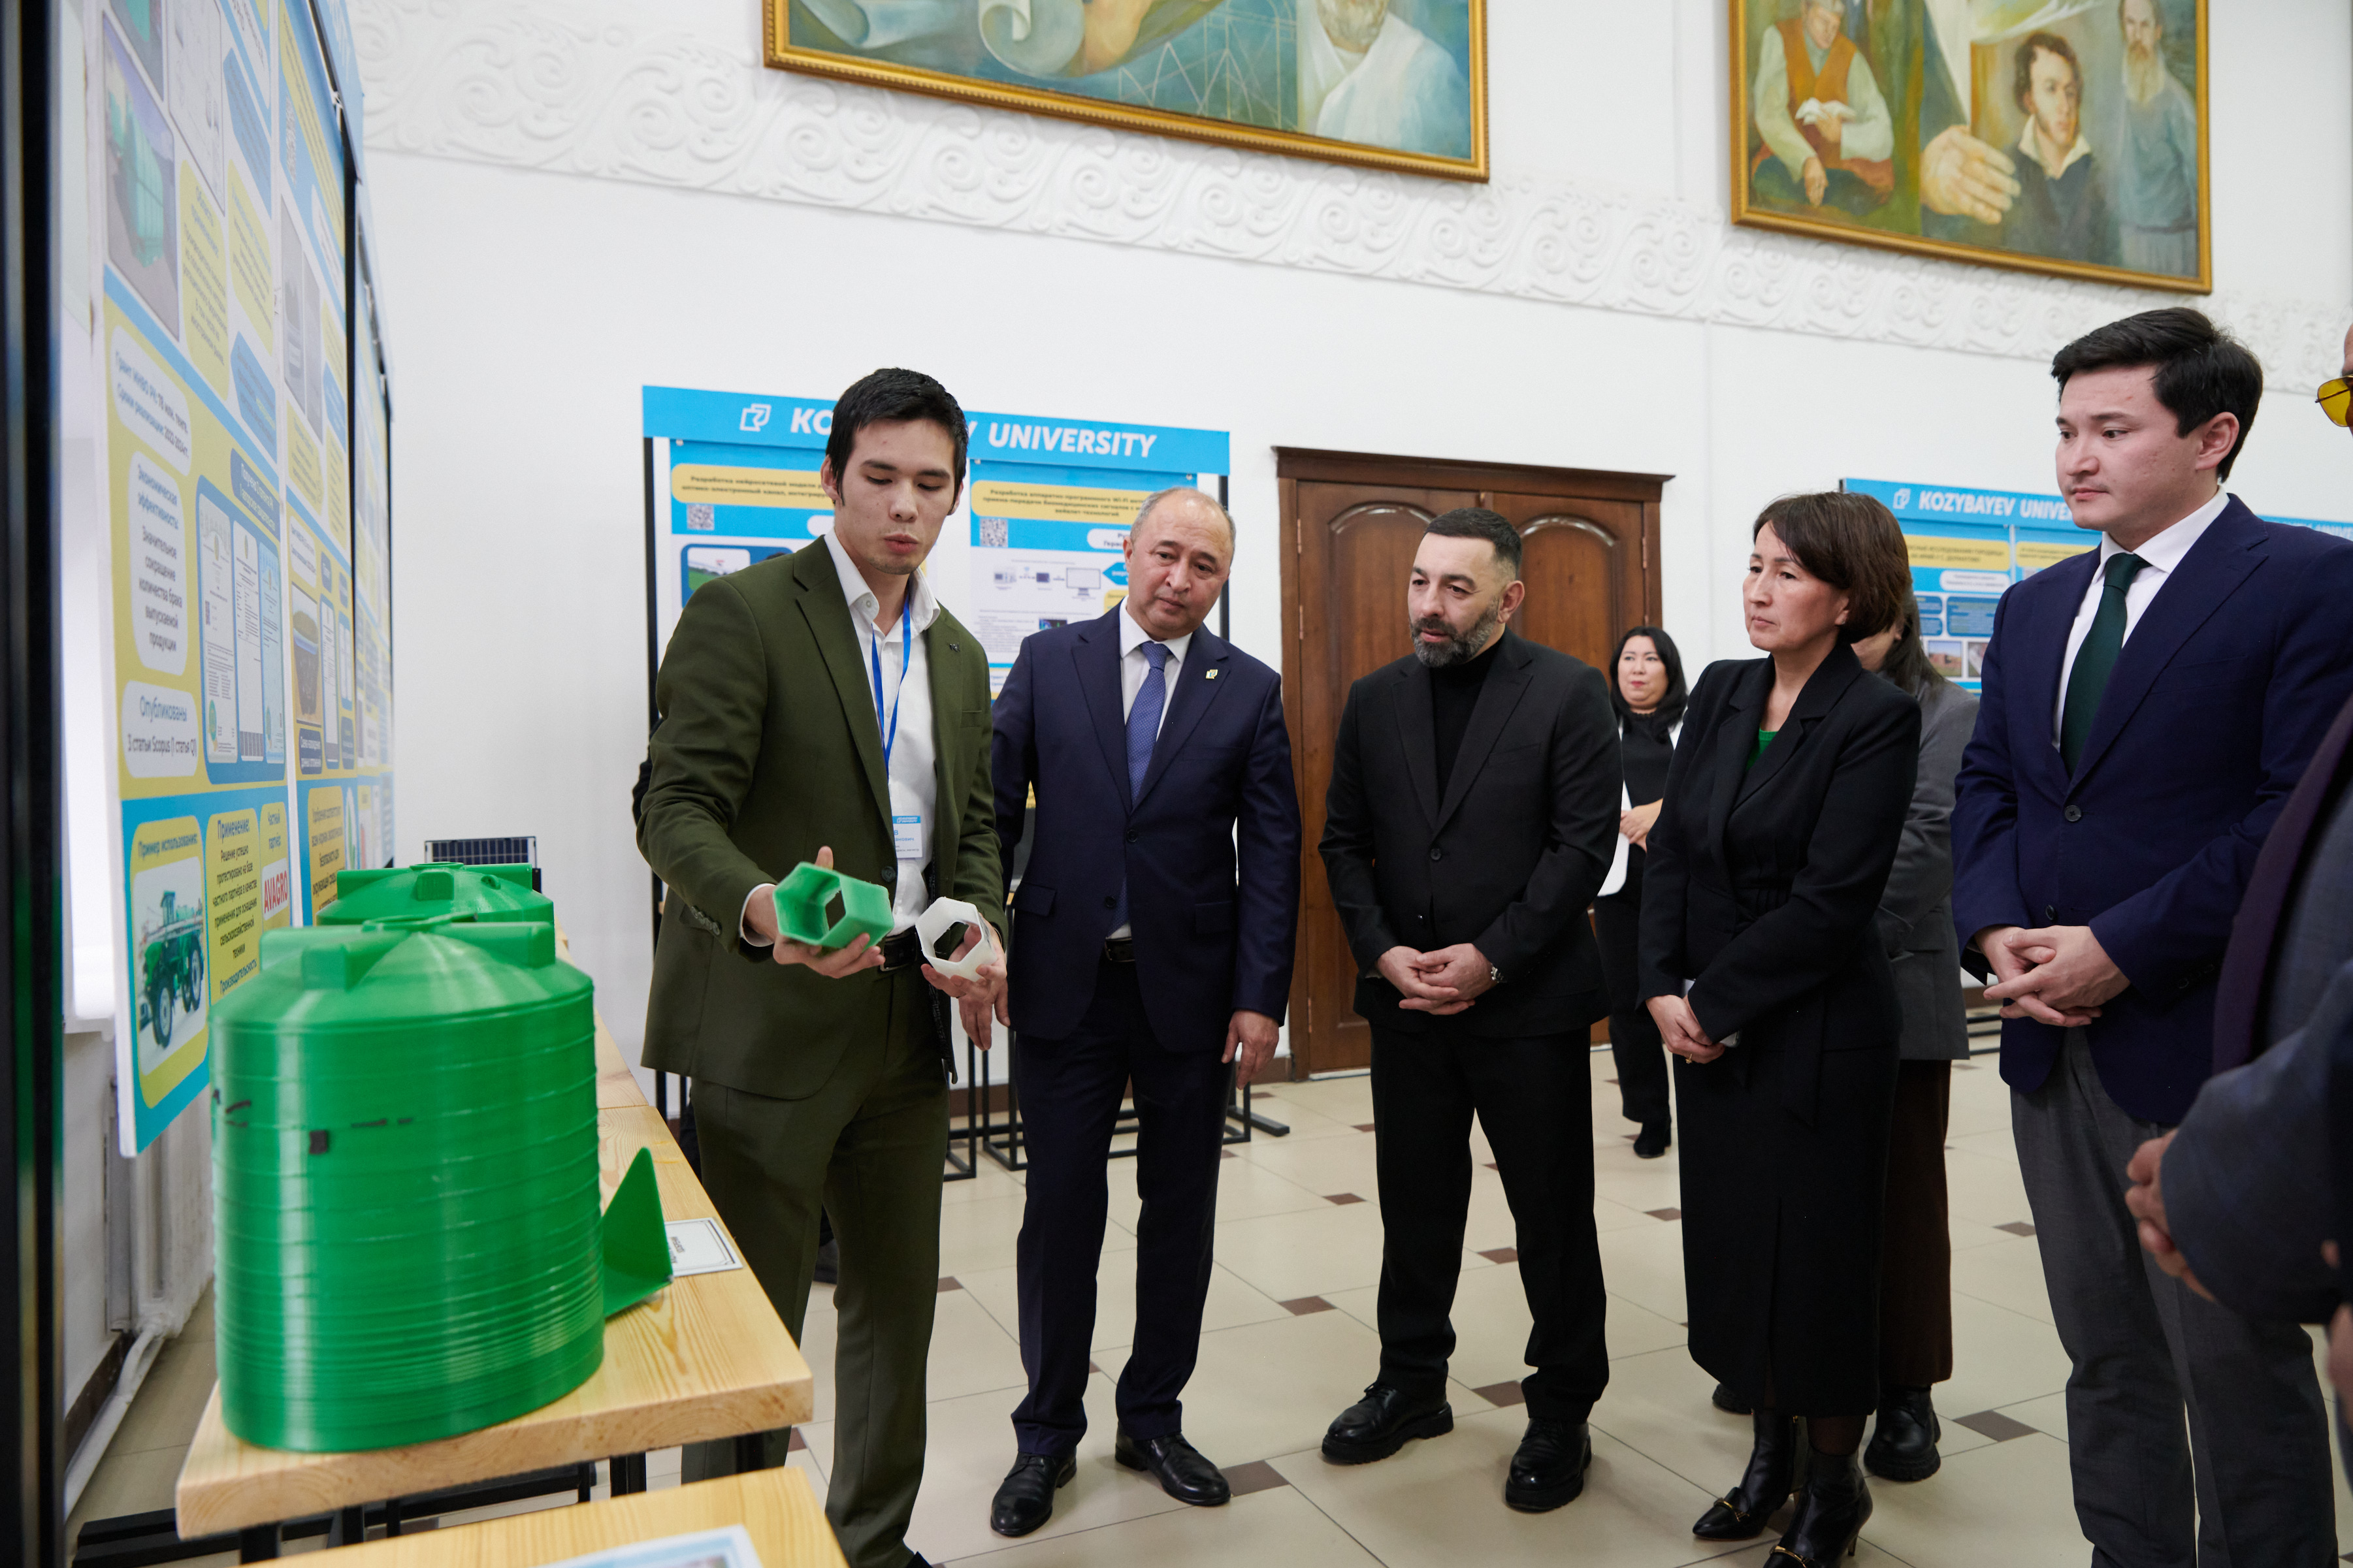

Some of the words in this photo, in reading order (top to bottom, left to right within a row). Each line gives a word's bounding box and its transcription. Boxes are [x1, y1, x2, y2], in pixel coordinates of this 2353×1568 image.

[988, 423, 1157, 457] UNIVERSITY
[1919, 491, 2016, 517] KOZYBAYEV
[2020, 499, 2072, 520] UNIVE
[142, 525, 176, 559] Значительное
[145, 555, 176, 582] сокращение
[138, 577, 168, 602] количества
[169, 587, 182, 609] брака
[145, 605, 178, 629] выпускаемой
[150, 632, 176, 652] продукции
[140, 695, 187, 723] Опубликованы
[133, 739, 151, 752] статьи
[152, 735, 170, 758] Scopus
[176, 741, 189, 753] статья
[218, 818, 250, 844] Применение:
[138, 840, 160, 860] Пример
[221, 850, 236, 863] Решение
[236, 845, 249, 861] успешно
[217, 866, 242, 888] протестировано
[213, 893, 228, 908] частного
[245, 879, 257, 893] качестве
[264, 870, 288, 914] AVAGRO
[215, 909, 235, 930] применения
[233, 944, 245, 960] техники
